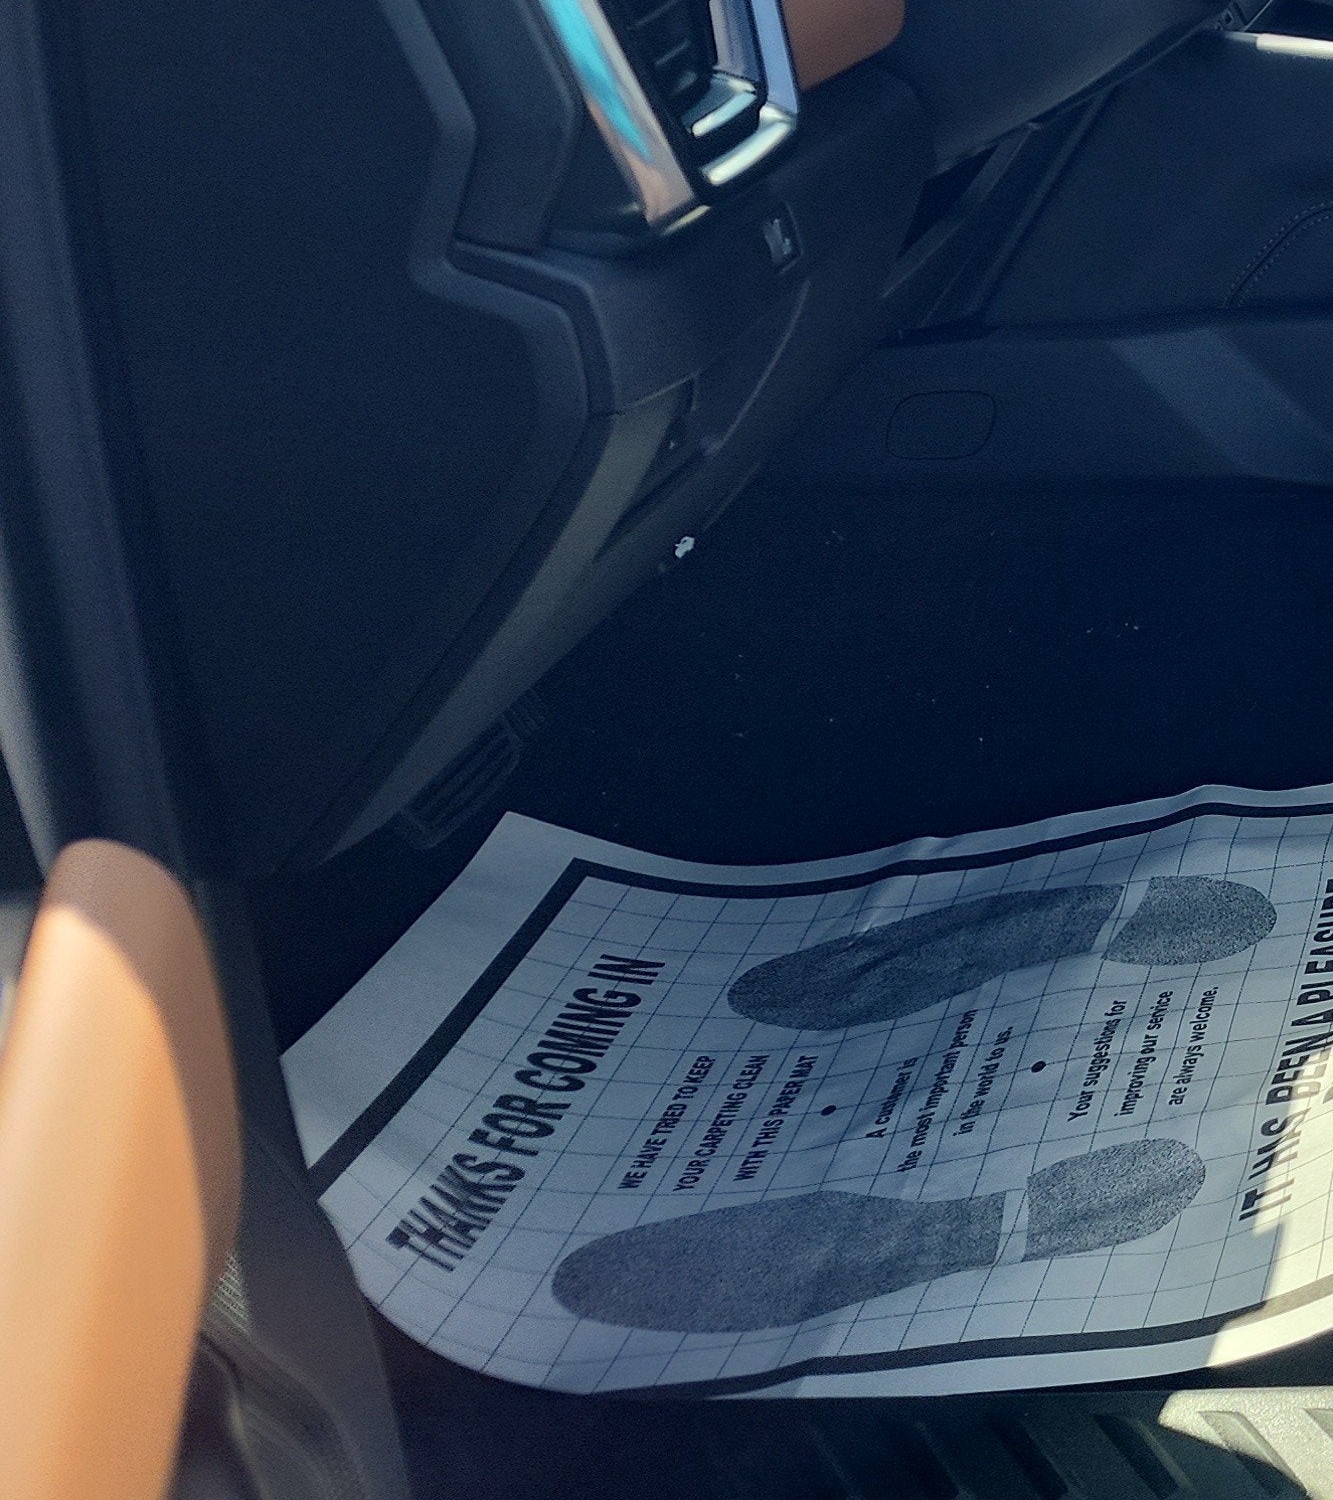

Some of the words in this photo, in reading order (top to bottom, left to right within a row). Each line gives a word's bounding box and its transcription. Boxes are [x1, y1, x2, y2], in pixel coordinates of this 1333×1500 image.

[588, 954, 666, 985] IN
[1147, 990, 1173, 1030] service
[1189, 986, 1219, 1043] welcome.
[515, 987, 642, 1092] COMING
[950, 1009, 978, 1049] person
[994, 1026, 1013, 1046] us.
[1140, 1034, 1159, 1055] our
[683, 1055, 716, 1085] KEEP
[897, 1057, 918, 1071] is
[985, 1047, 1005, 1061] to
[1067, 1090, 1095, 1122] Your
[1083, 1018, 1121, 1087] suggestions
[1105, 1000, 1128, 1017] for
[1173, 1045, 1204, 1084] always
[672, 1086, 698, 1100] TO
[918, 1051, 960, 1112] important
[974, 1062, 999, 1098] world
[1114, 1056, 1156, 1117] improving
[1169, 1087, 1187, 1105] are
[875, 1071, 912, 1125] customer
[960, 1100, 985, 1120] the
[468, 1094, 571, 1157] FOR
[650, 1103, 687, 1135] TRIED
[673, 1159, 710, 1192] YOUR
[694, 1092, 748, 1156] CARPETING
[732, 1054, 770, 1090] CLEAN
[733, 1150, 769, 1181] WITH
[752, 1119, 784, 1148] THIS
[768, 1081, 804, 1118] PAPER
[789, 1055, 819, 1079] MAT
[865, 1127, 887, 1138] A
[910, 1112, 935, 1147] most
[953, 1121, 976, 1137] in
[631, 1138, 667, 1169] HAVE
[1248, 1107, 1311, 1180] HAS
[897, 1151, 922, 1172] the
[617, 1171, 647, 1189] WE
[385, 1153, 525, 1272] THANKS
[1238, 1178, 1295, 1221] IT
